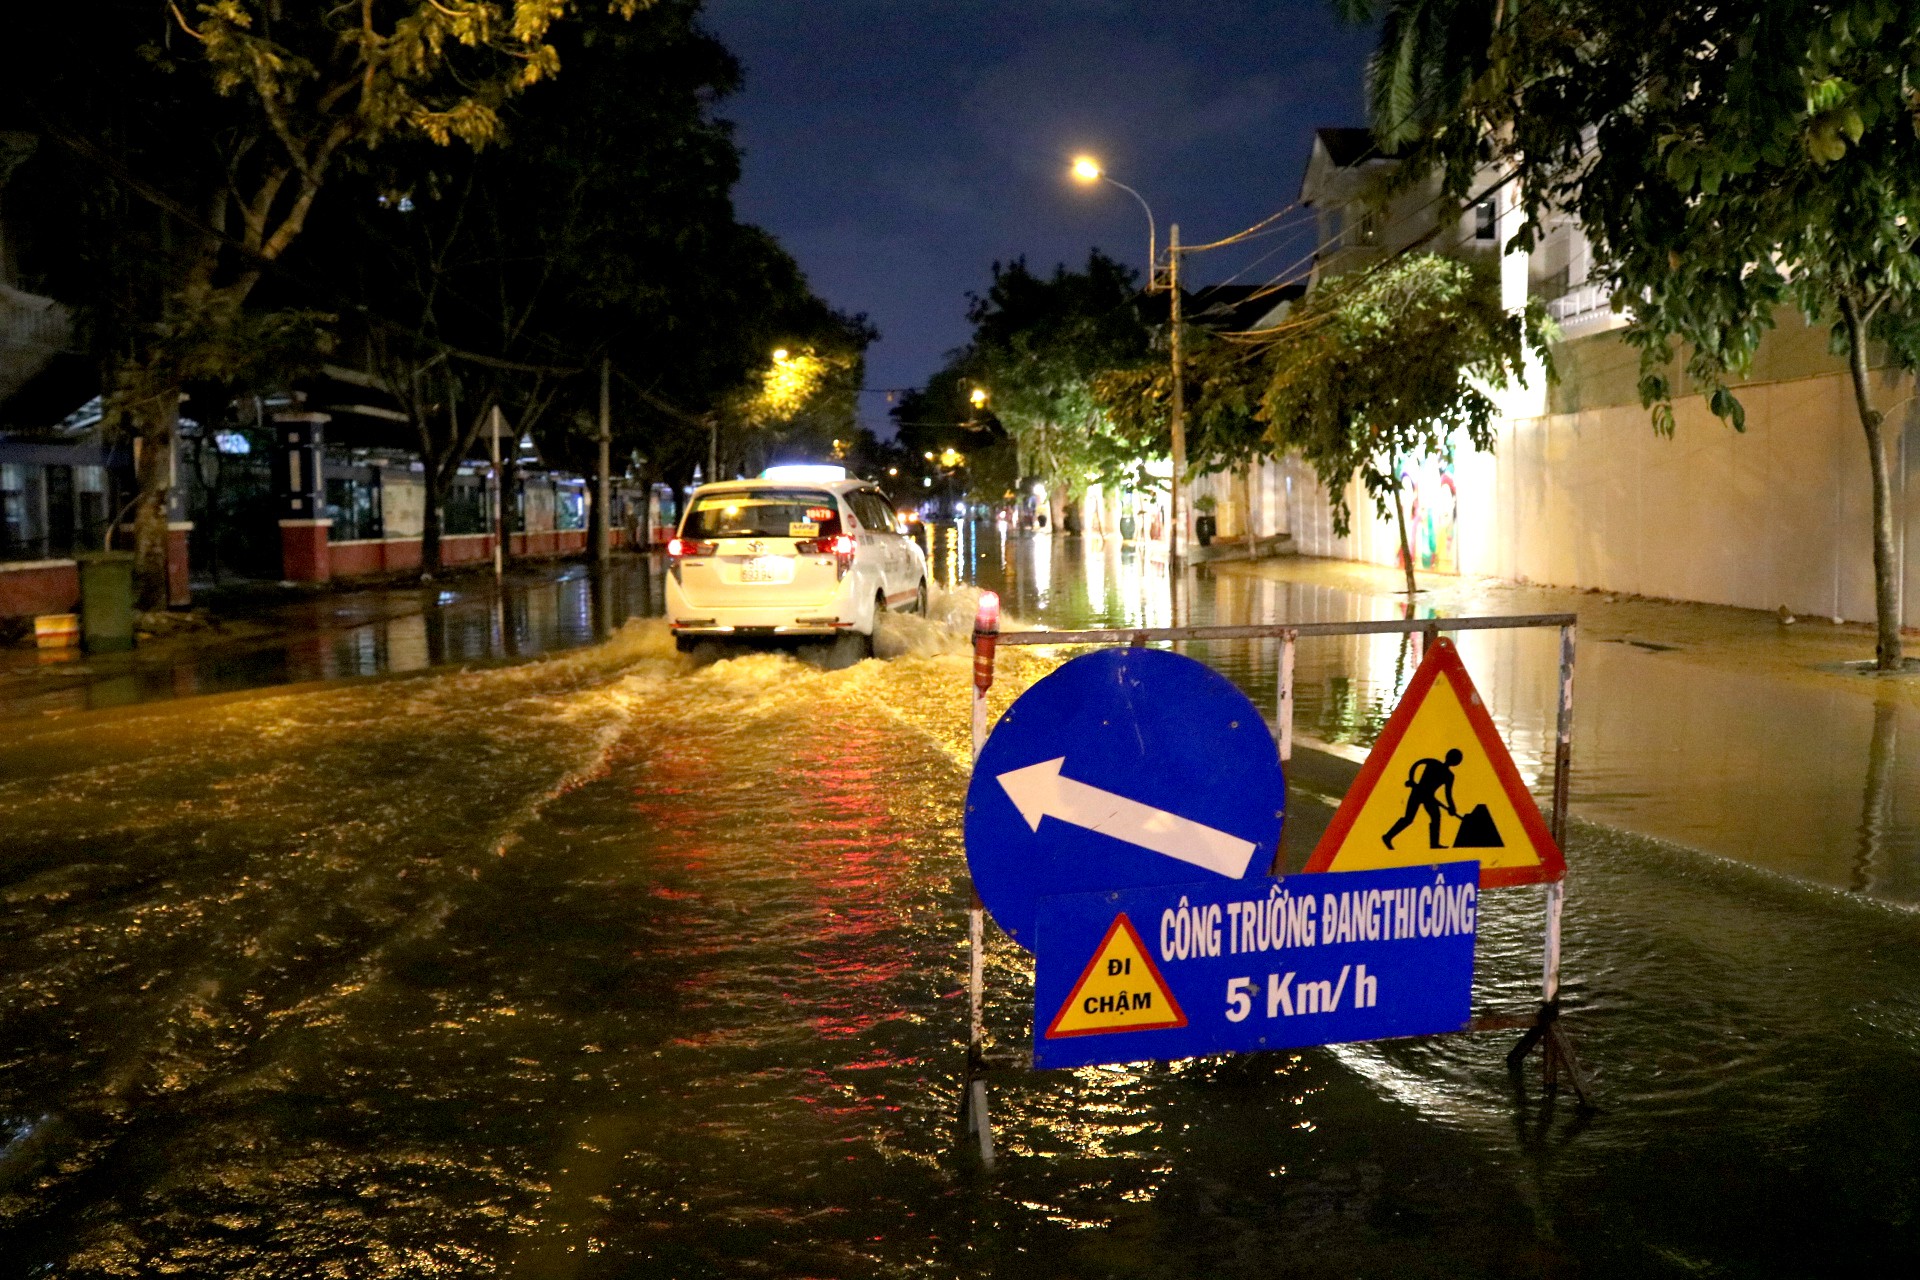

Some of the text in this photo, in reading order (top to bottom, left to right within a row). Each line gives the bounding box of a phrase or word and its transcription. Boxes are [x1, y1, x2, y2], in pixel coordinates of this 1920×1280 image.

[1160, 895, 1222, 962] CÔNG
[1227, 884, 1317, 954] TRƯỜNG
[1107, 958, 1131, 976] ĐI
[1083, 990, 1152, 1015] CHẬM
[1225, 964, 1377, 1023] 5 Km/h
